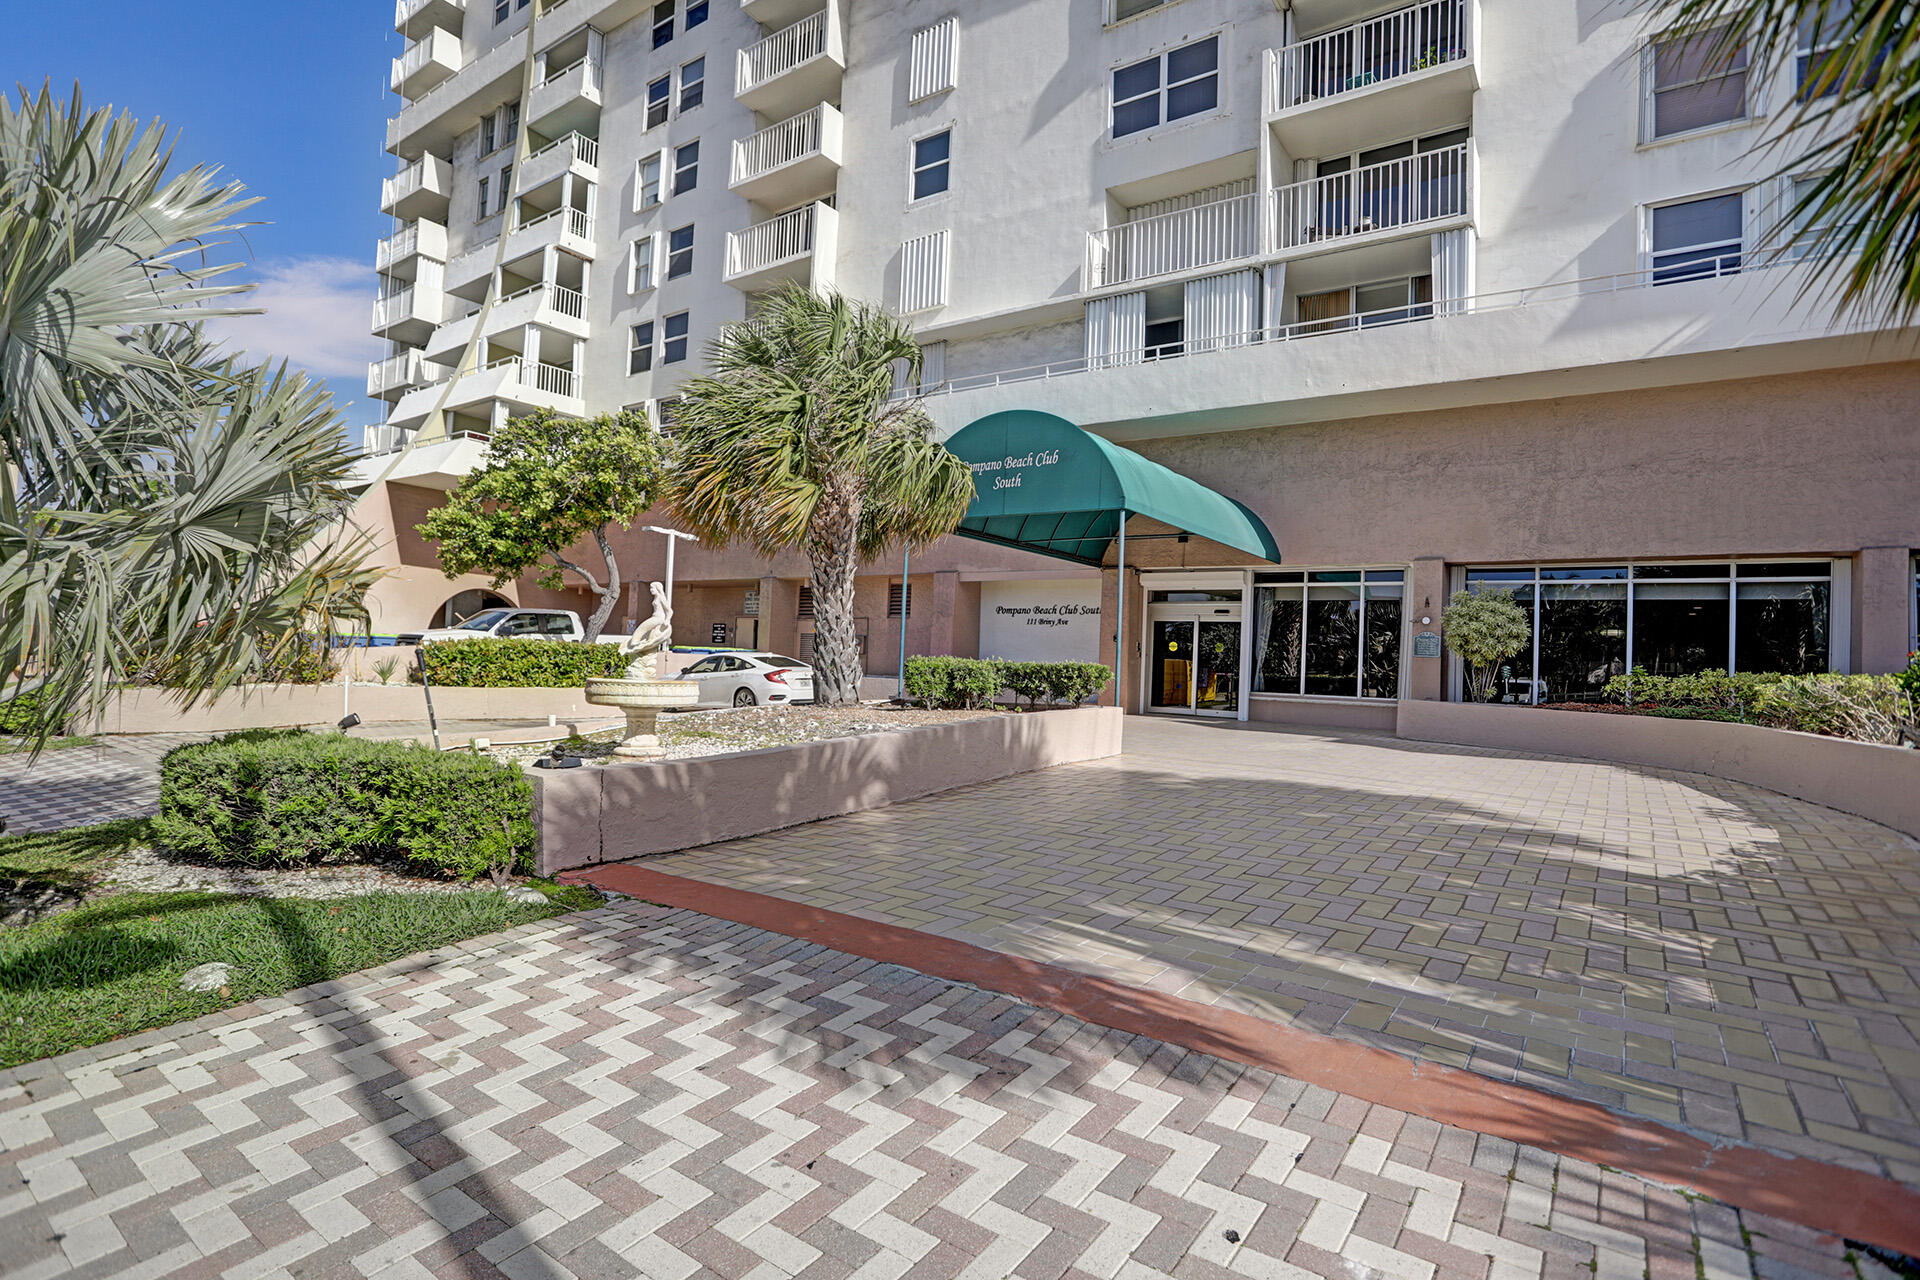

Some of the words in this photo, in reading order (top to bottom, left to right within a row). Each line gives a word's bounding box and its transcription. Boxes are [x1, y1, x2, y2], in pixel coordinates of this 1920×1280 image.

[1004, 452, 1033, 469] Beach
[1035, 450, 1059, 467] Club
[992, 473, 1022, 490] South
[995, 605, 1031, 617] Pompano
[1033, 604, 1057, 615] Beach
[1058, 604, 1078, 615] Club
[1079, 605, 1102, 615] Sout
[1038, 617, 1055, 627] Briny
[1055, 618, 1069, 626] Ave
